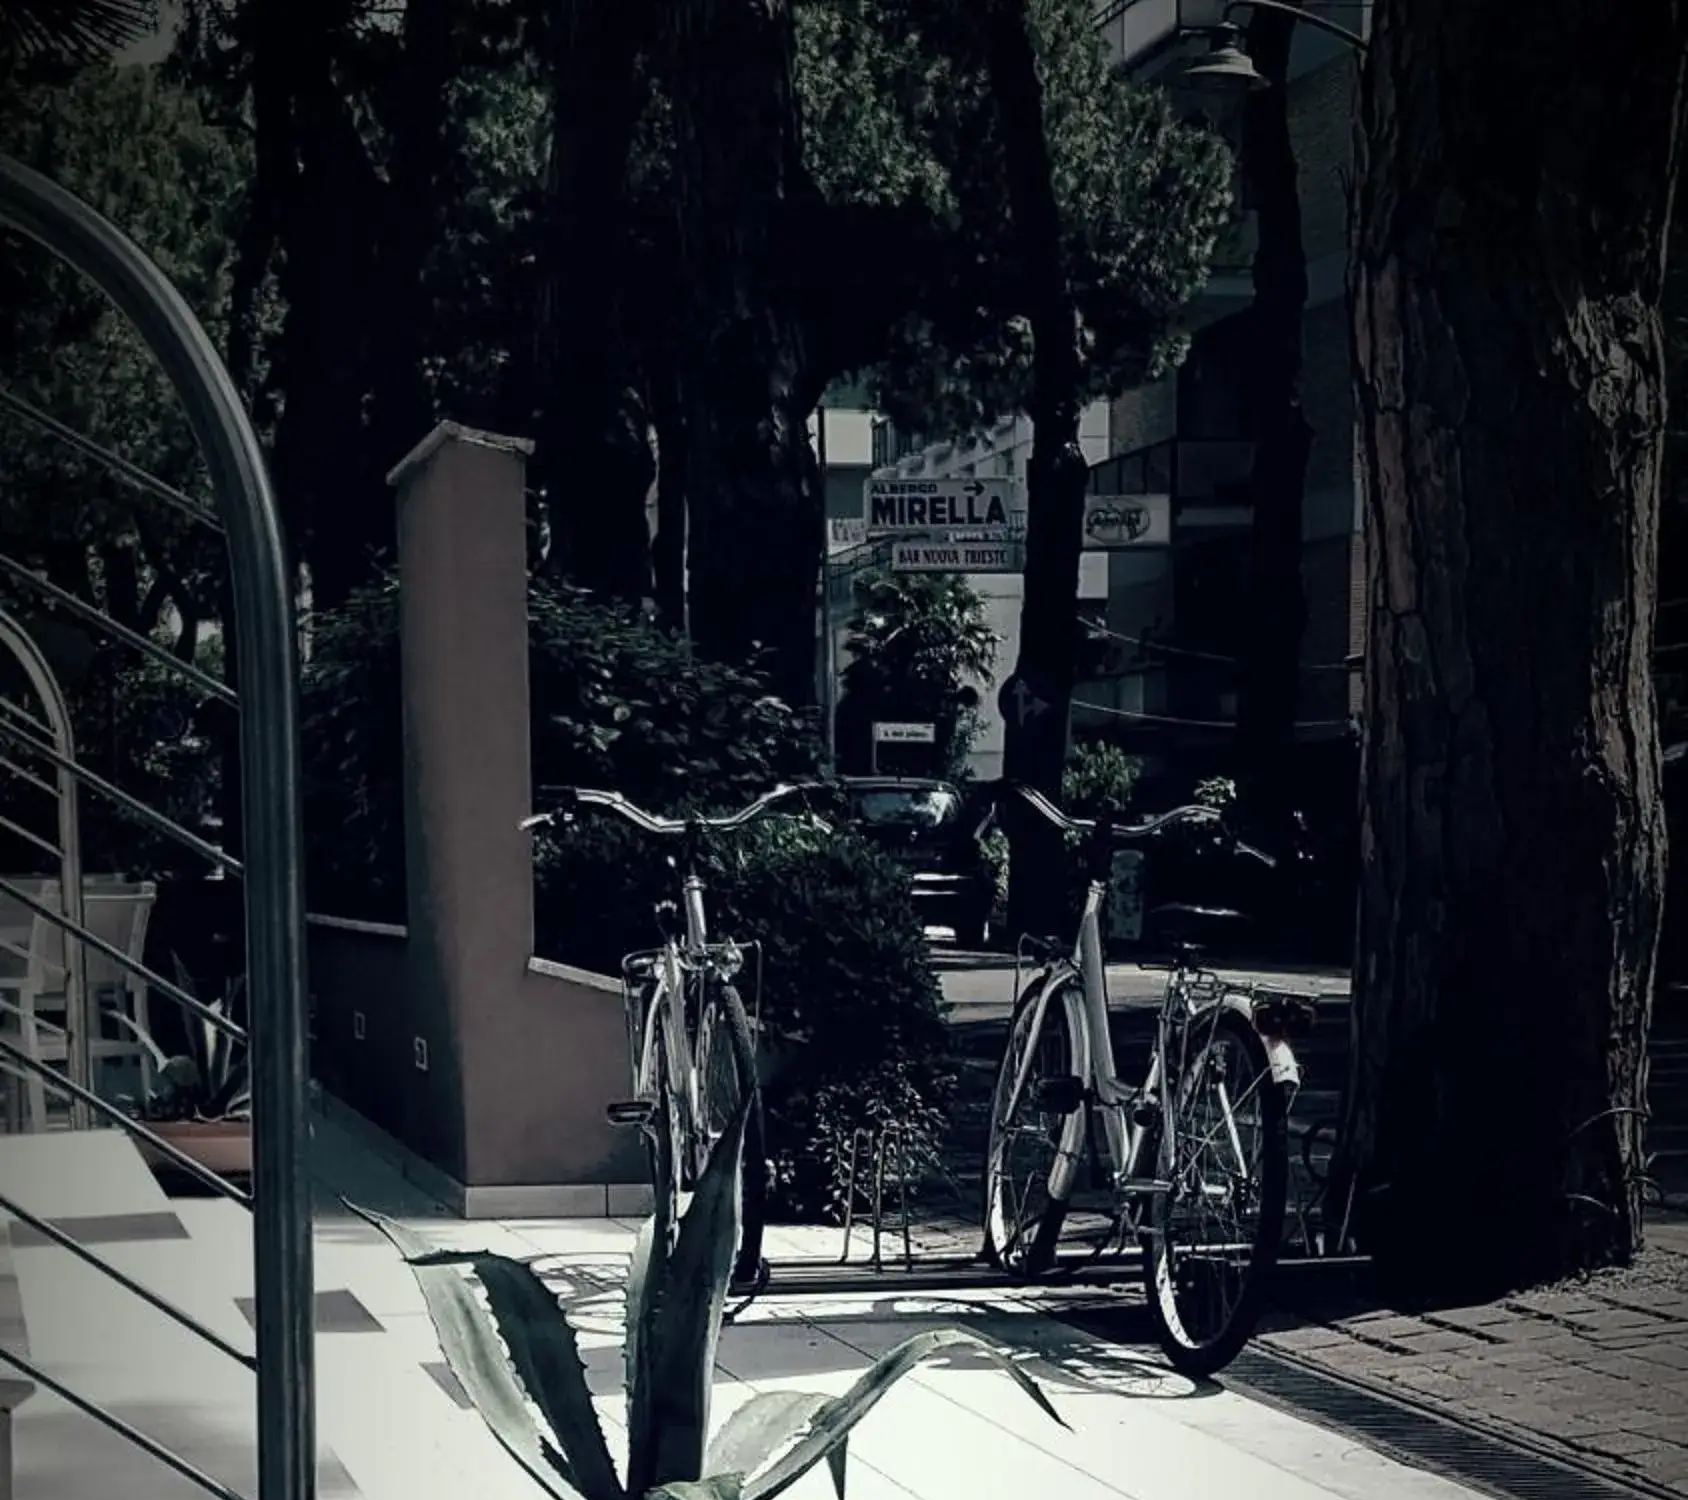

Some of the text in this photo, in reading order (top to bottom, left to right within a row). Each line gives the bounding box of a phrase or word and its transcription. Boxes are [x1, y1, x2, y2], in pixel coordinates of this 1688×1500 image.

[871, 483, 937, 494] ALBERGO
[871, 496, 1006, 525] MIRELLA
[899, 551, 920, 564] BAR
[964, 551, 1008, 565] TRIESTE
